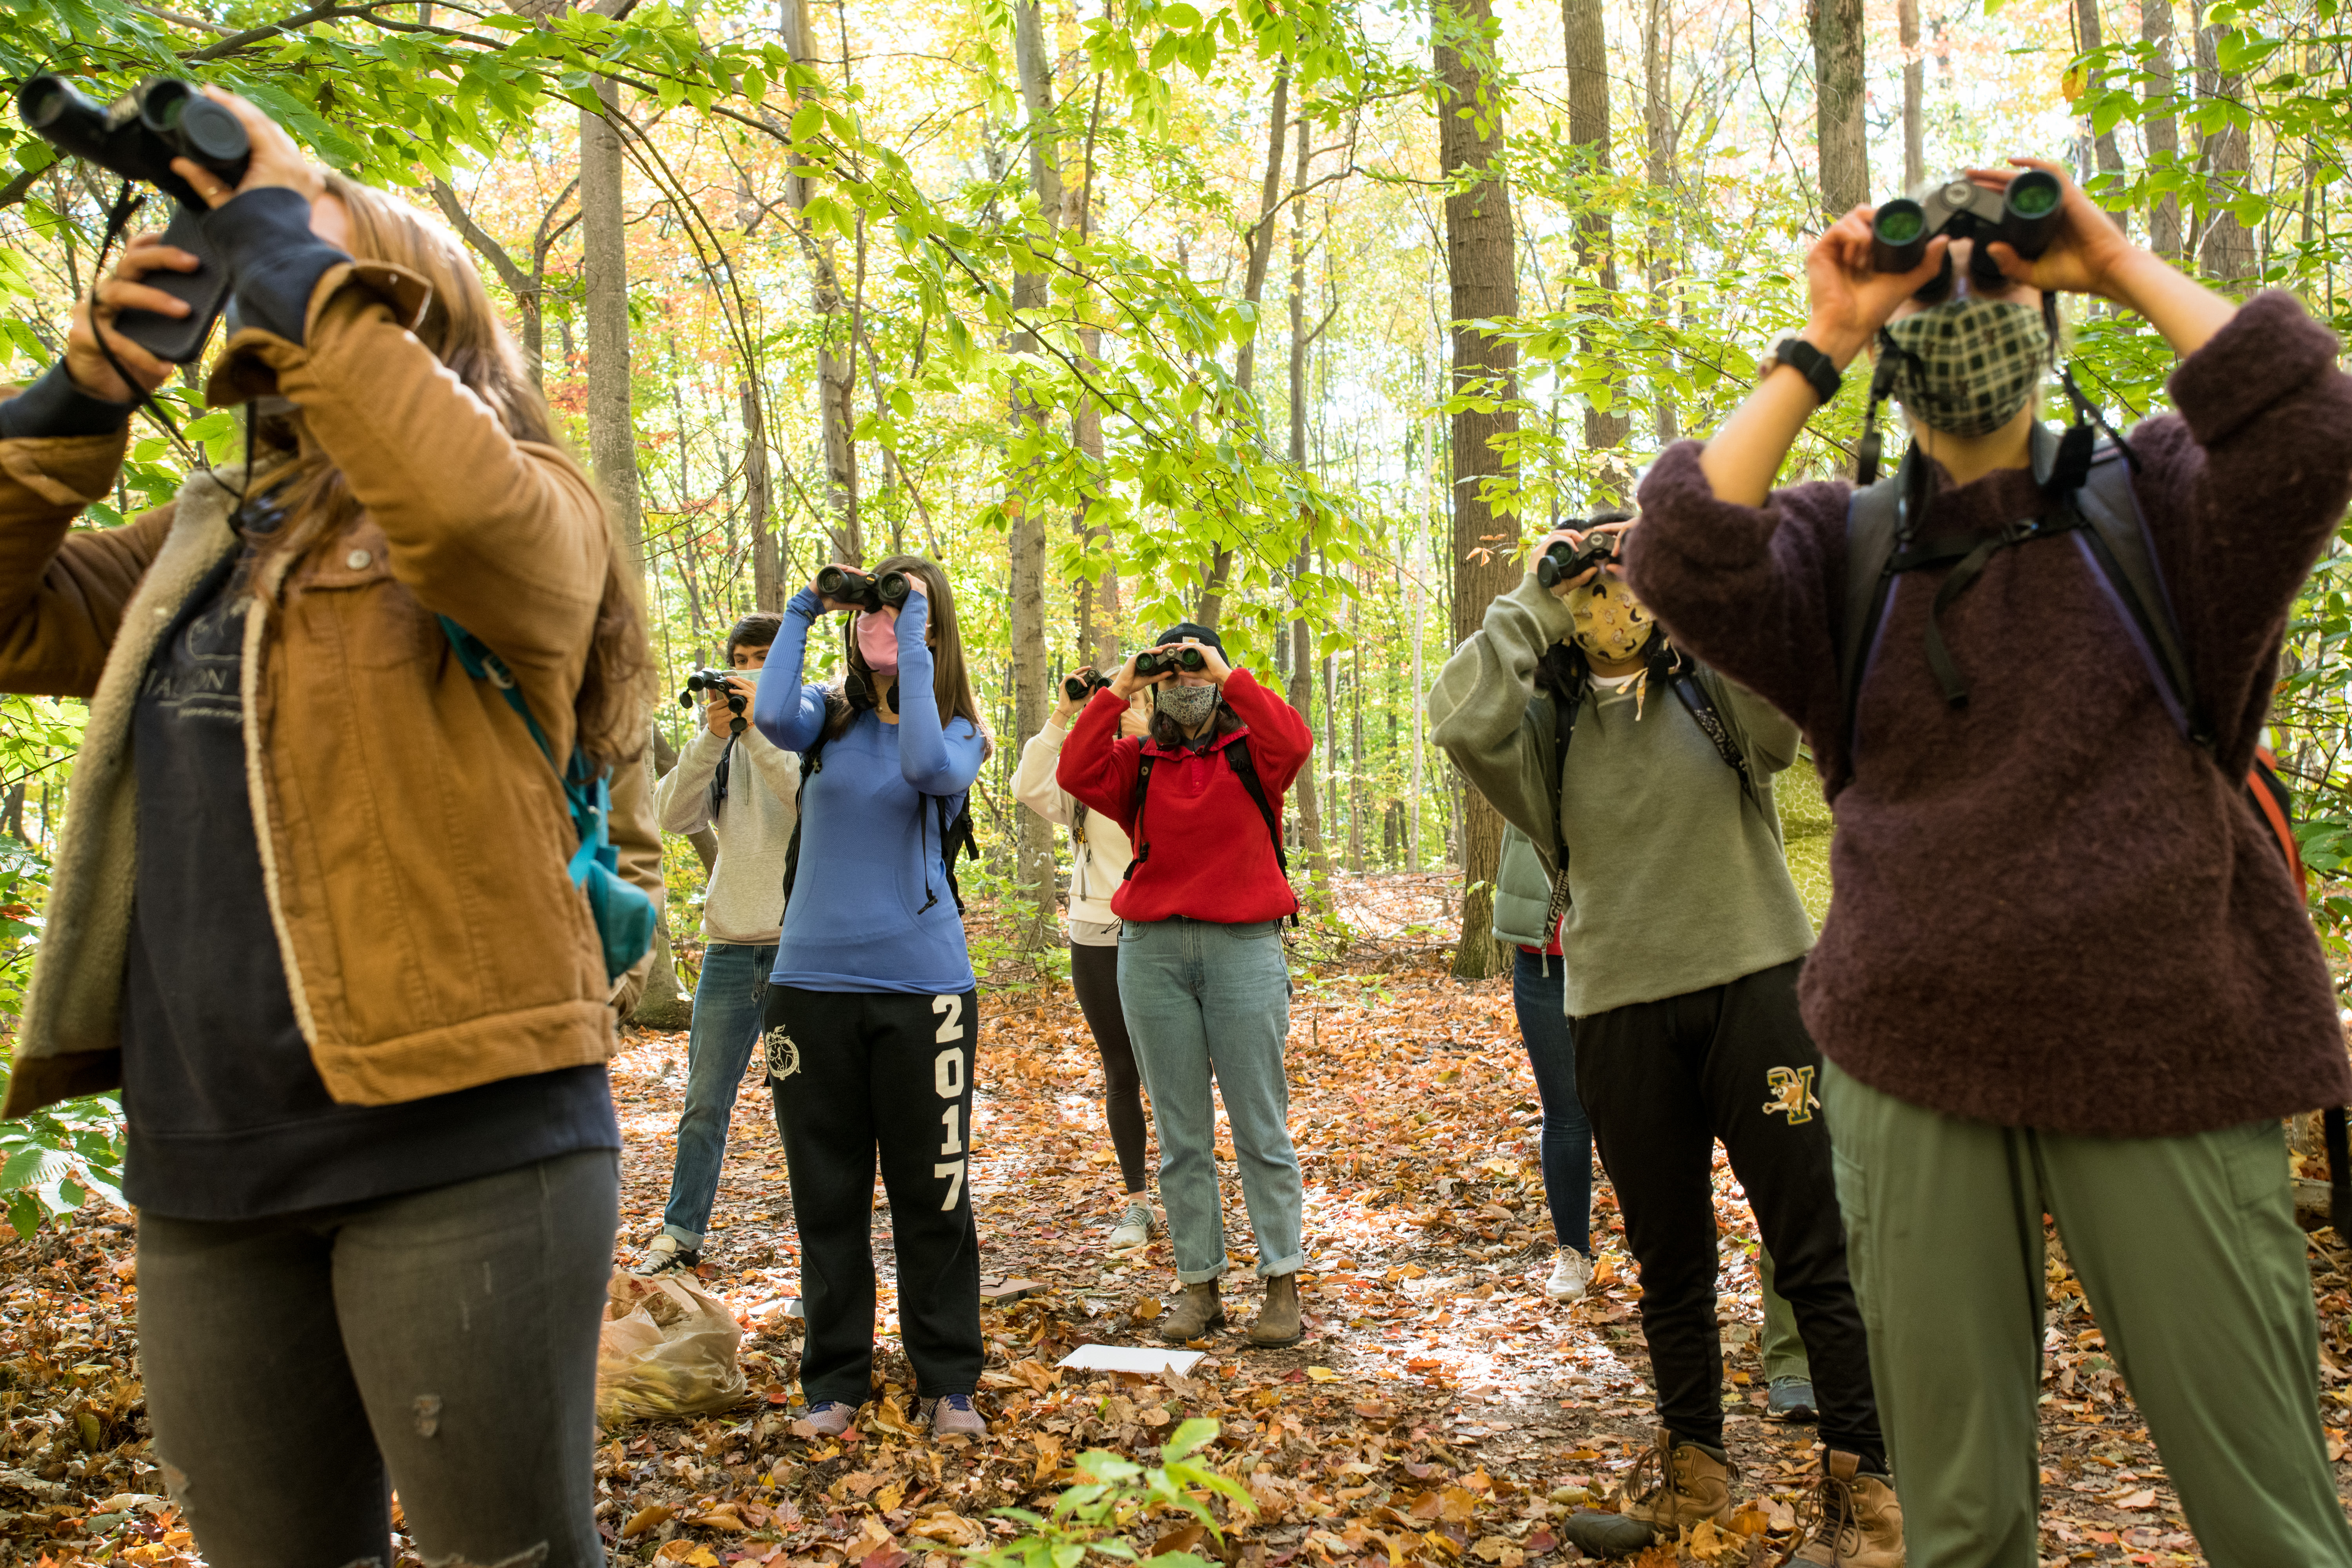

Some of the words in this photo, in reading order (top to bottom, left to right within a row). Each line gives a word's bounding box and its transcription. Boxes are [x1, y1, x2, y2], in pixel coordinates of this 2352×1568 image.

[1551, 868, 1565, 906] FASHION
[1556, 871, 1568, 911] LEISUR
[789, 1041, 797, 1057] SCHOOL
[932, 995, 964, 1210] 2017
